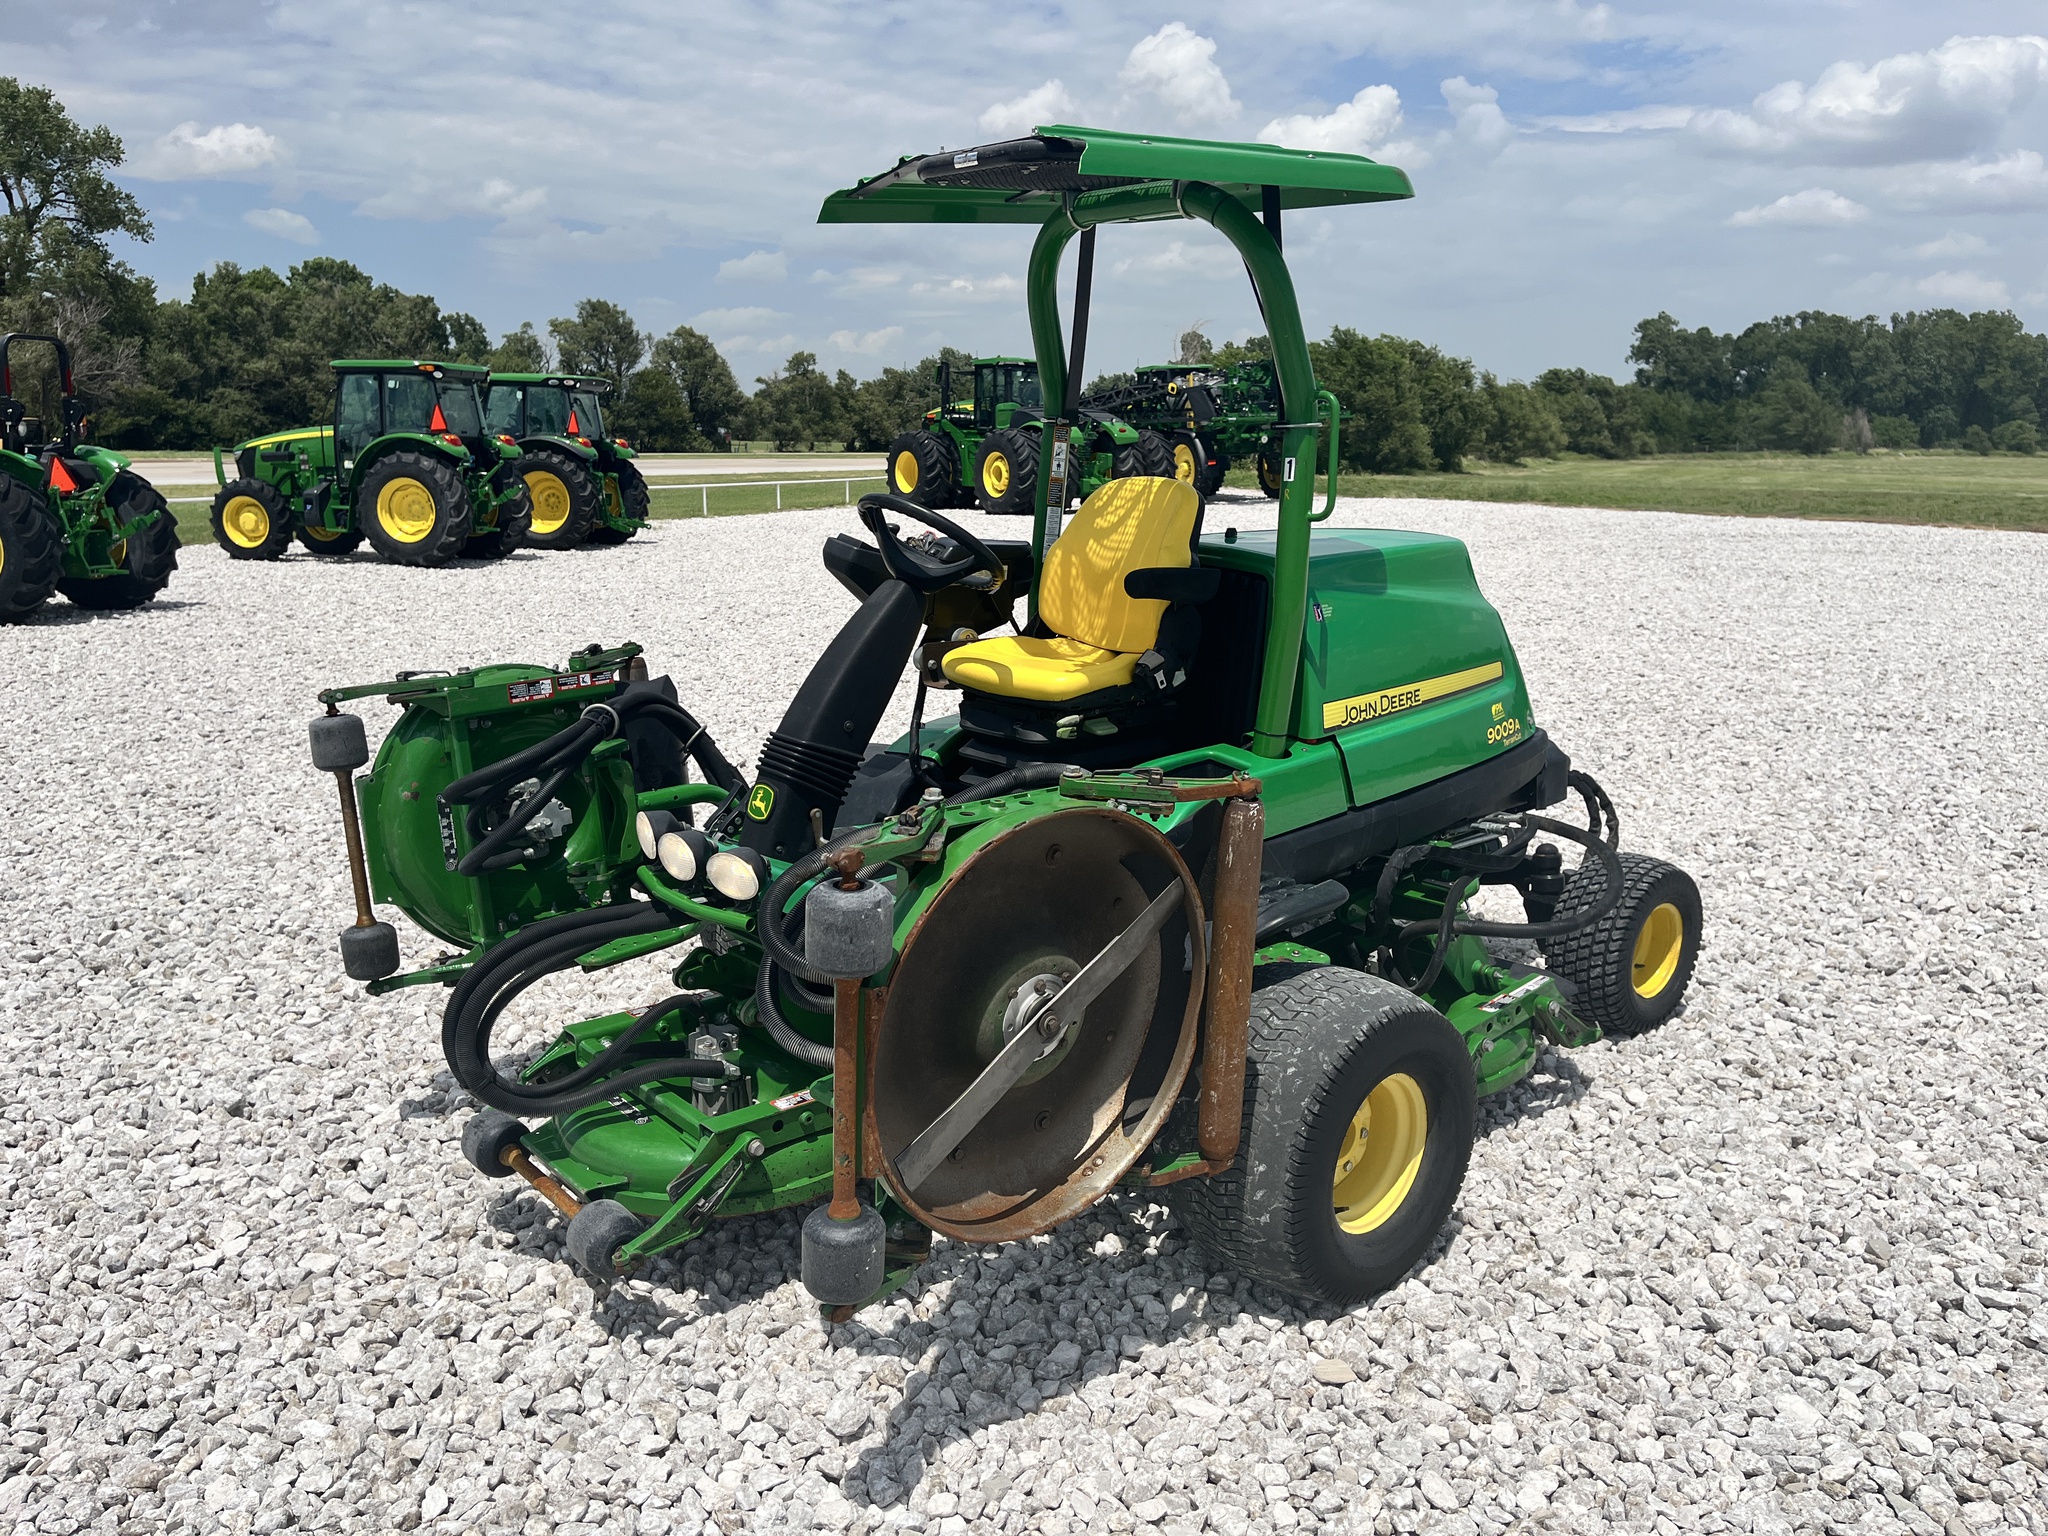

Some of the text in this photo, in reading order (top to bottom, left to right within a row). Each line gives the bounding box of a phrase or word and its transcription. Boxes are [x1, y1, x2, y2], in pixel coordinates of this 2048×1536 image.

[1287, 459, 1293, 480] 1
[1341, 689, 1421, 725] JOHN DEERE
[1487, 718, 1521, 745] 9009A
